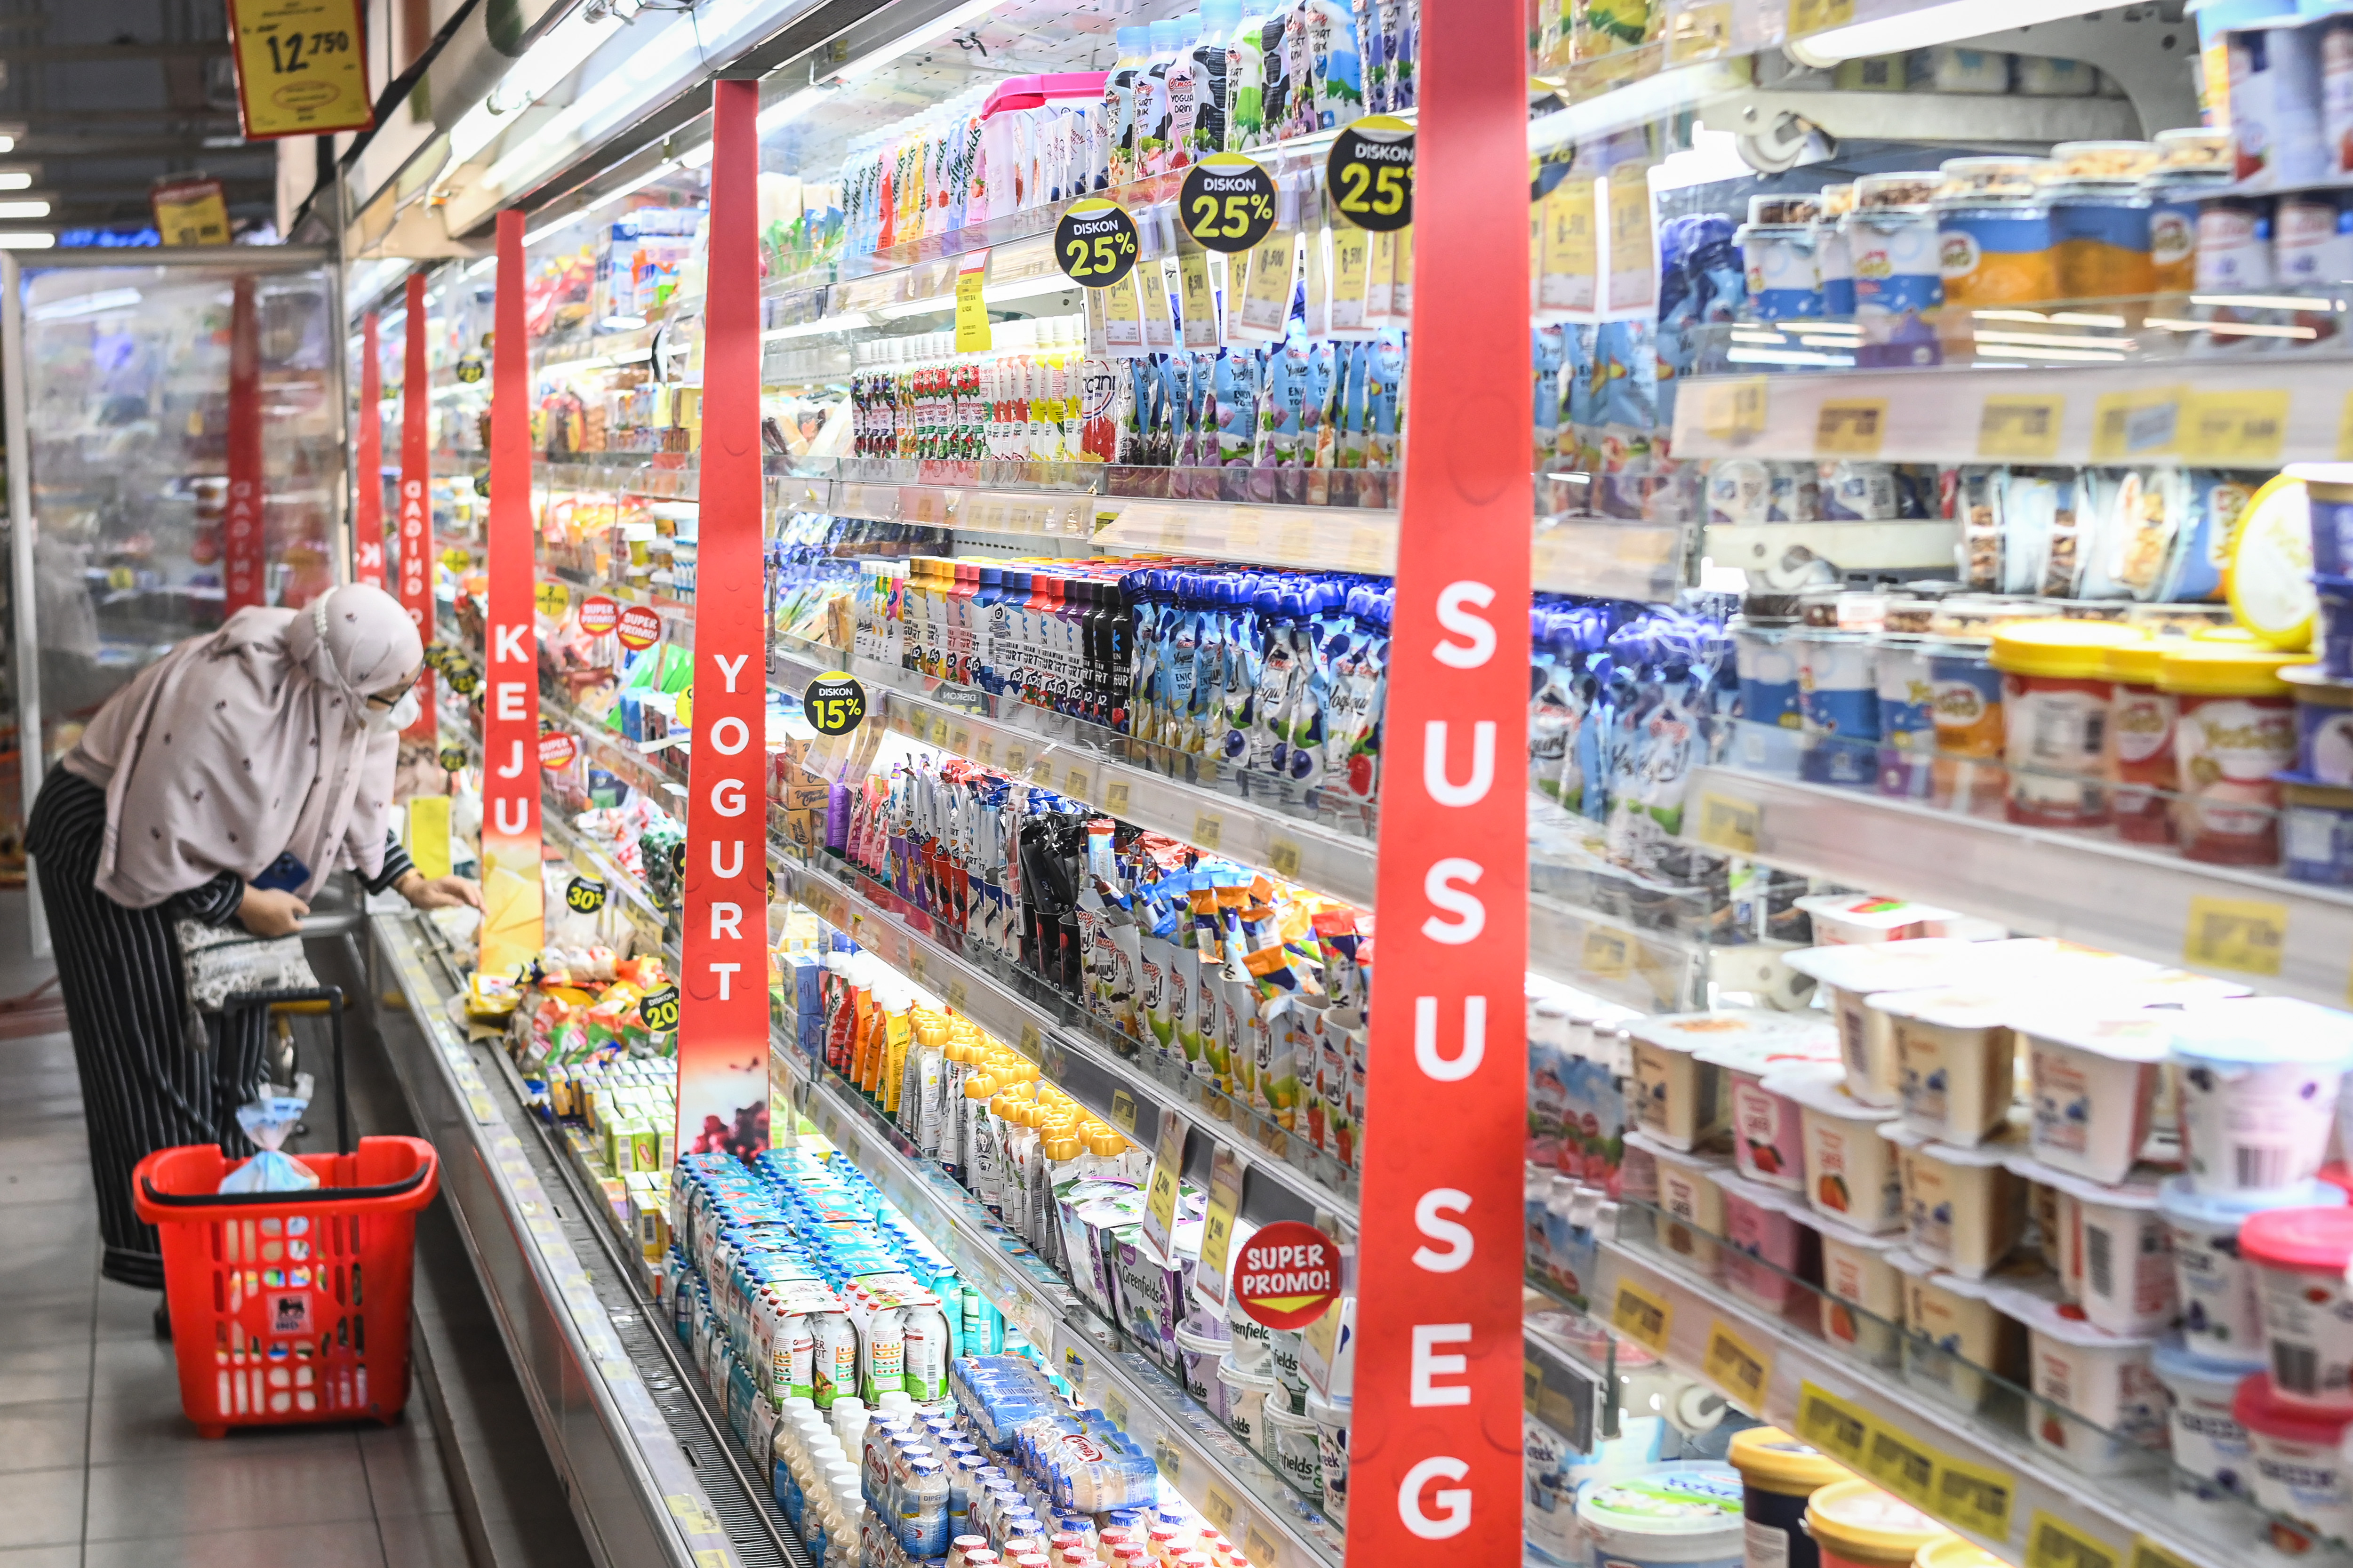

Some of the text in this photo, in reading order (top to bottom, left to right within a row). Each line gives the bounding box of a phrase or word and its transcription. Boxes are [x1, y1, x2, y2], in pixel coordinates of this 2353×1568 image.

[1204, 178, 1256, 192] DISKON
[1192, 193, 1272, 238] 25%
[1073, 220, 1118, 236] DISKON
[1066, 232, 1135, 277] 25%
[624, 613, 657, 629] SUPER
[619, 623, 657, 640] PROMO!
[1012, 672, 1022, 681] A2
[819, 688, 853, 697] DISKON
[1071, 689, 1081, 699] A2
[1084, 692, 1093, 702] A2
[1098, 695, 1107, 705] A2
[813, 698, 861, 729] 15%
[495, 624, 530, 835] KEJU
[709, 655, 750, 1001] YOGURT
[1415, 580, 1497, 1081] SUSU
[568, 887, 604, 910] 30%
[648, 992, 675, 1007] DISKON
[1247, 1244, 1324, 1271] SUPER
[1123, 1265, 1160, 1304] Greenfields
[1242, 1270, 1330, 1296] PROMO!
